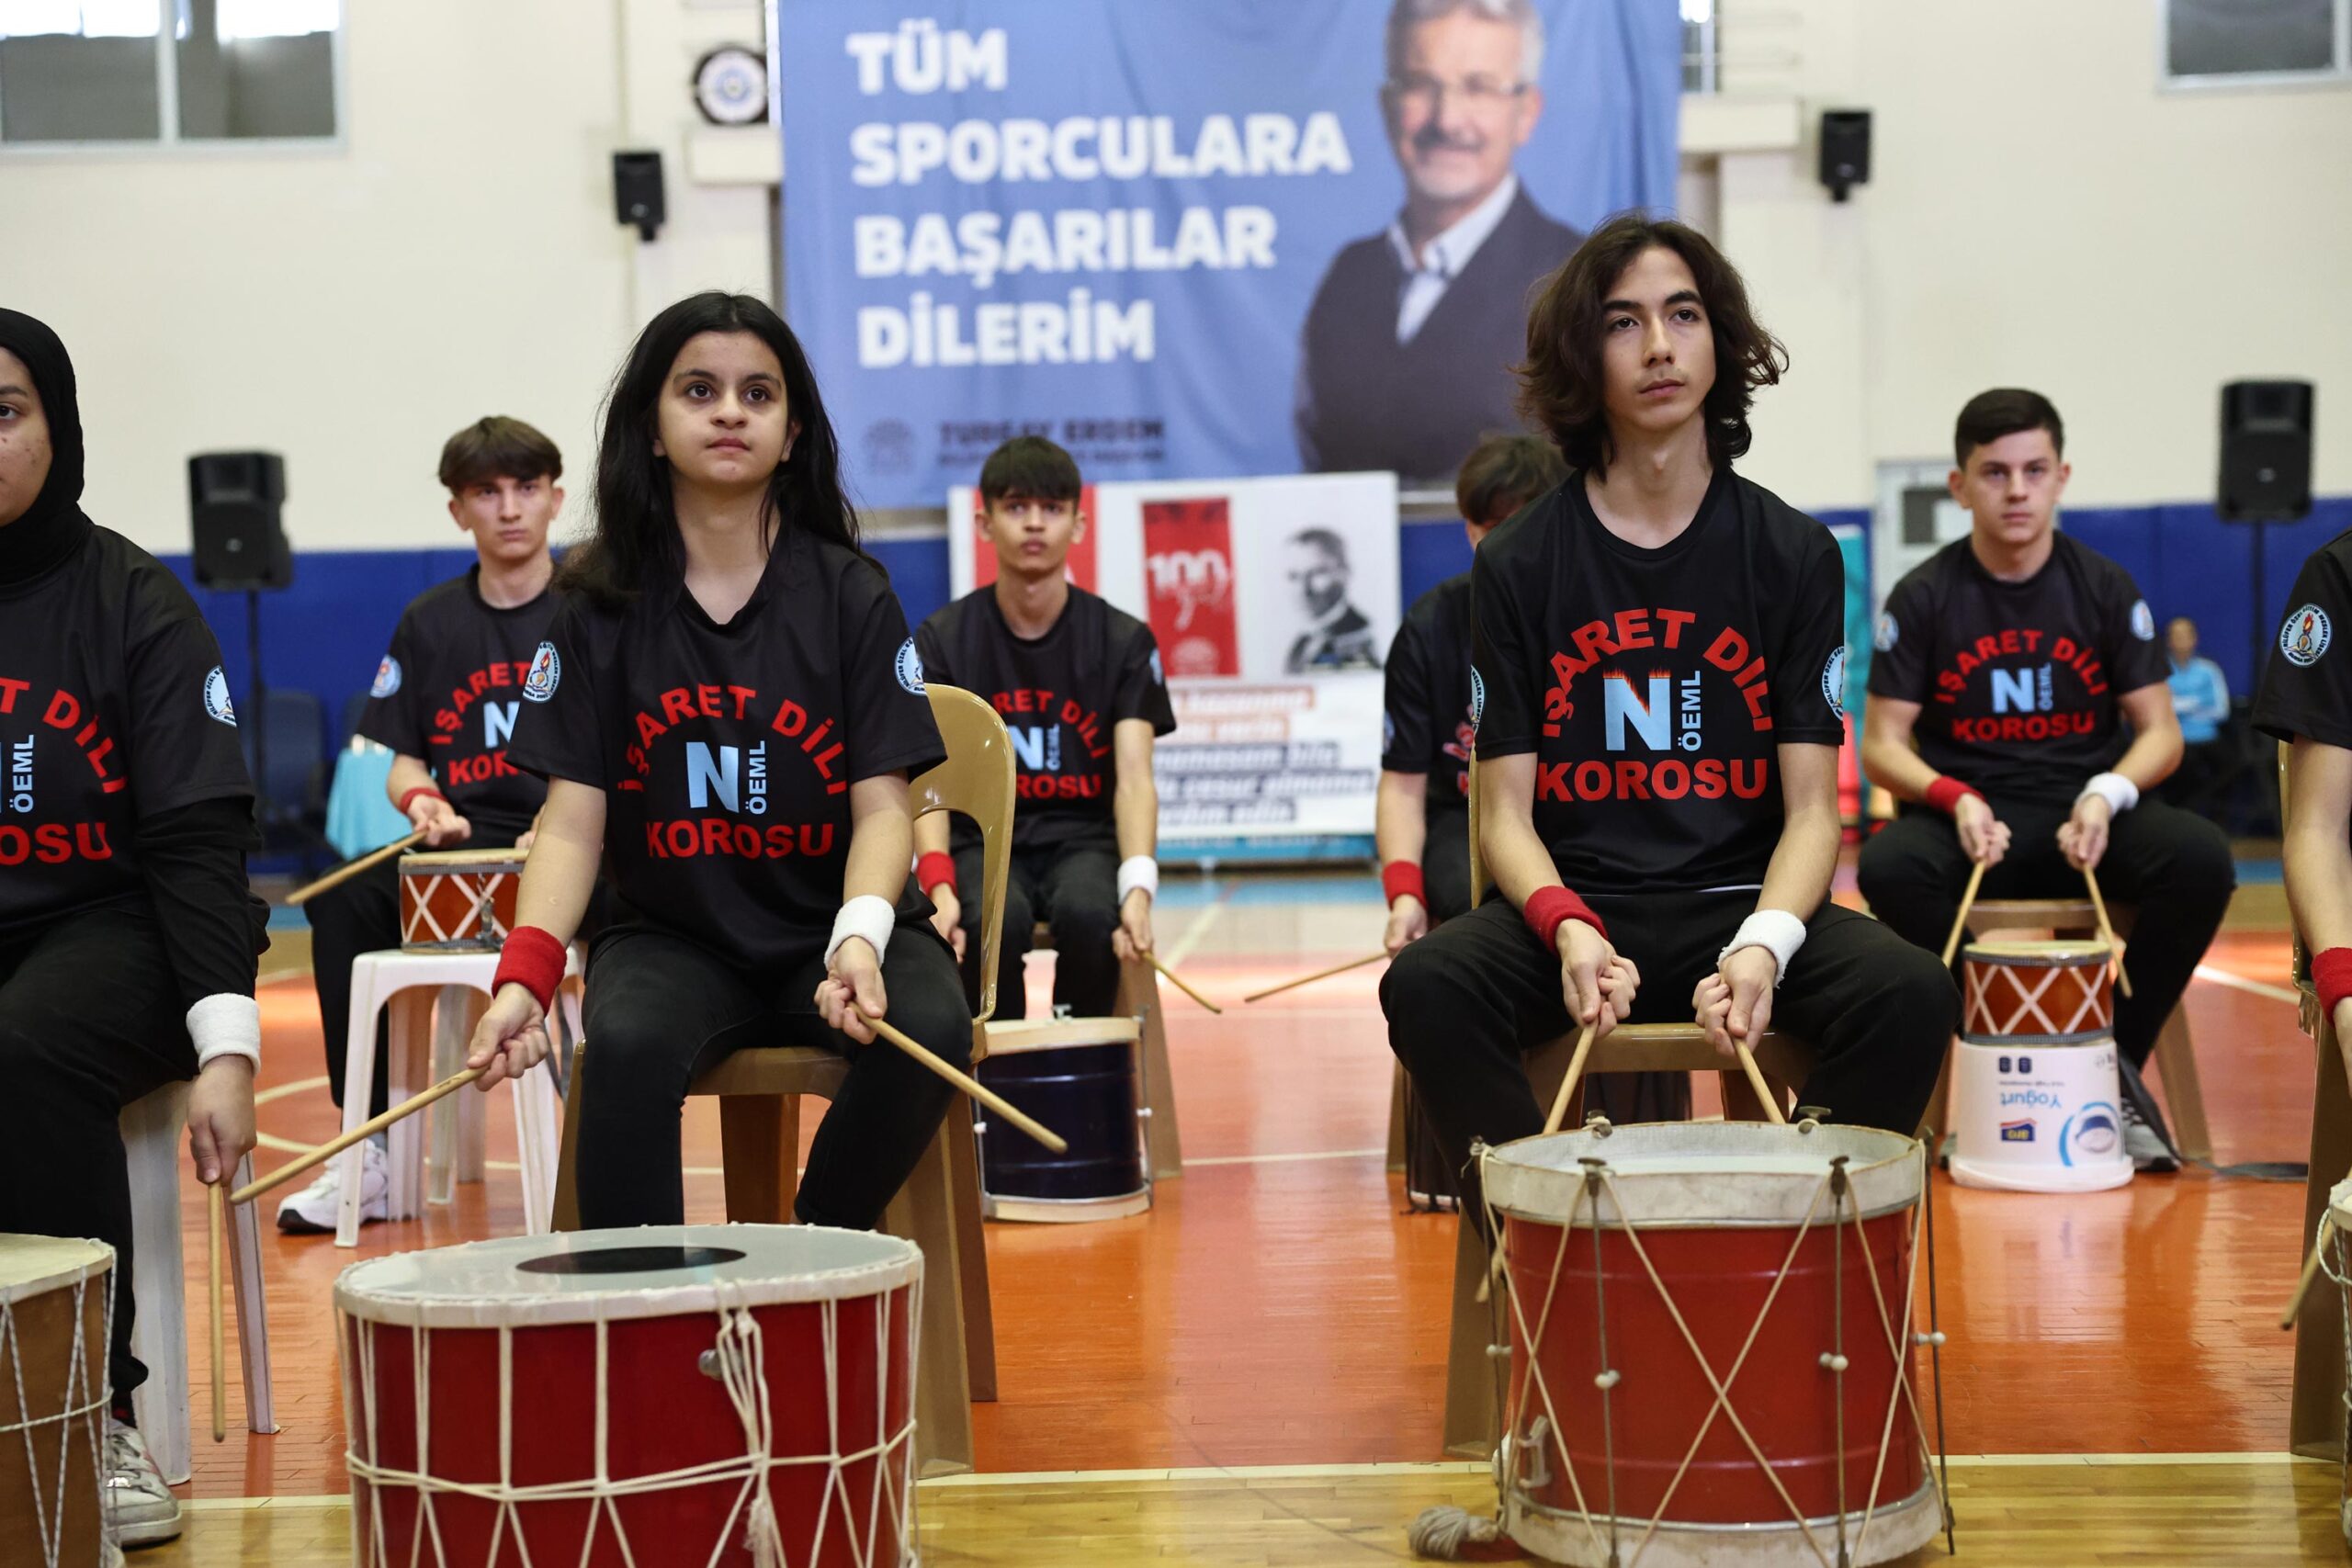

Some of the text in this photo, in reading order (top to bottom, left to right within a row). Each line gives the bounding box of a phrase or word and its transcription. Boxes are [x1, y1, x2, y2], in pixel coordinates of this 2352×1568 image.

[845, 18, 1009, 94] TÜM
[850, 112, 1352, 186] SPORCULARA
[855, 207, 1277, 288] BAŞARILAR
[858, 288, 1155, 367] DİLERİM
[1603, 672, 1671, 751] N
[1678, 671, 1702, 751] ÖEML
[1951, 710, 2096, 742] KOROSU
[1990, 667, 2036, 714] N
[9, 735, 34, 813] ÖEML
[448, 750, 519, 786] KOR
[617, 682, 757, 793] İŞARET
[686, 741, 740, 814] N
[745, 740, 767, 815] ÖEML
[1016, 773, 1102, 799] ROSU
[1537, 758, 1768, 802] KOROSU
[0, 822, 112, 865] OSU
[646, 818, 834, 860] KOROSU
